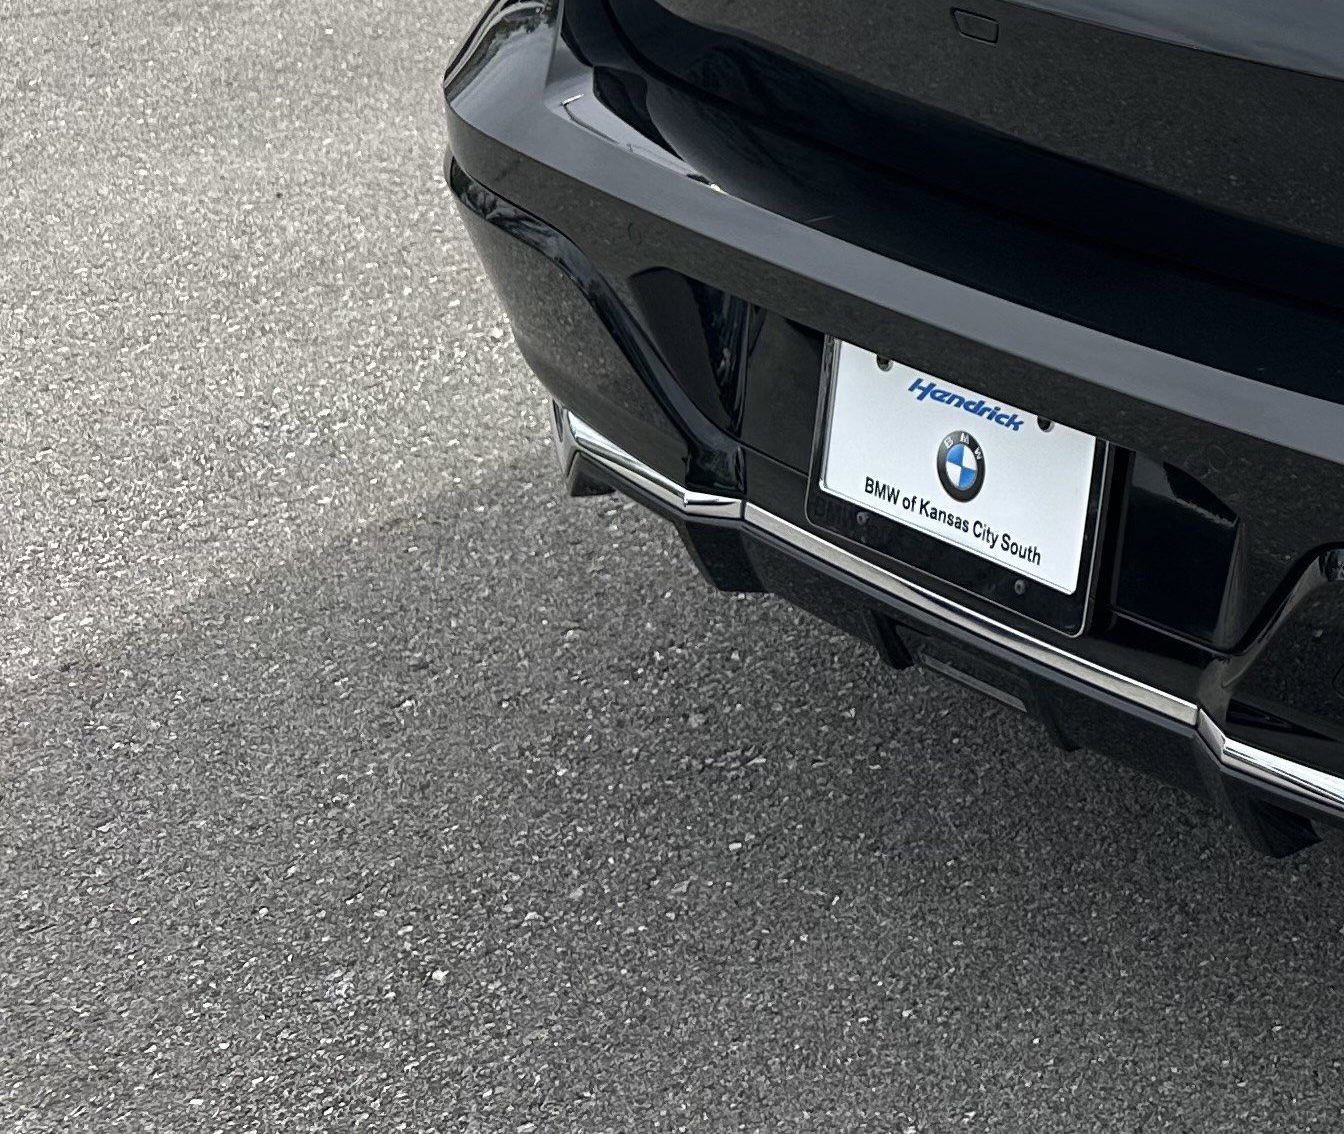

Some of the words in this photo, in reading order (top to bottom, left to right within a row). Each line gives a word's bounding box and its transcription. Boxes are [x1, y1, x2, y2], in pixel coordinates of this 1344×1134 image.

[907, 377, 1025, 432] Hendrick
[943, 432, 983, 461] BMW
[864, 475, 901, 506] BMW
[902, 494, 917, 512] of
[919, 498, 970, 534] Kansas
[972, 519, 999, 550] City
[1000, 533, 1042, 566] South
